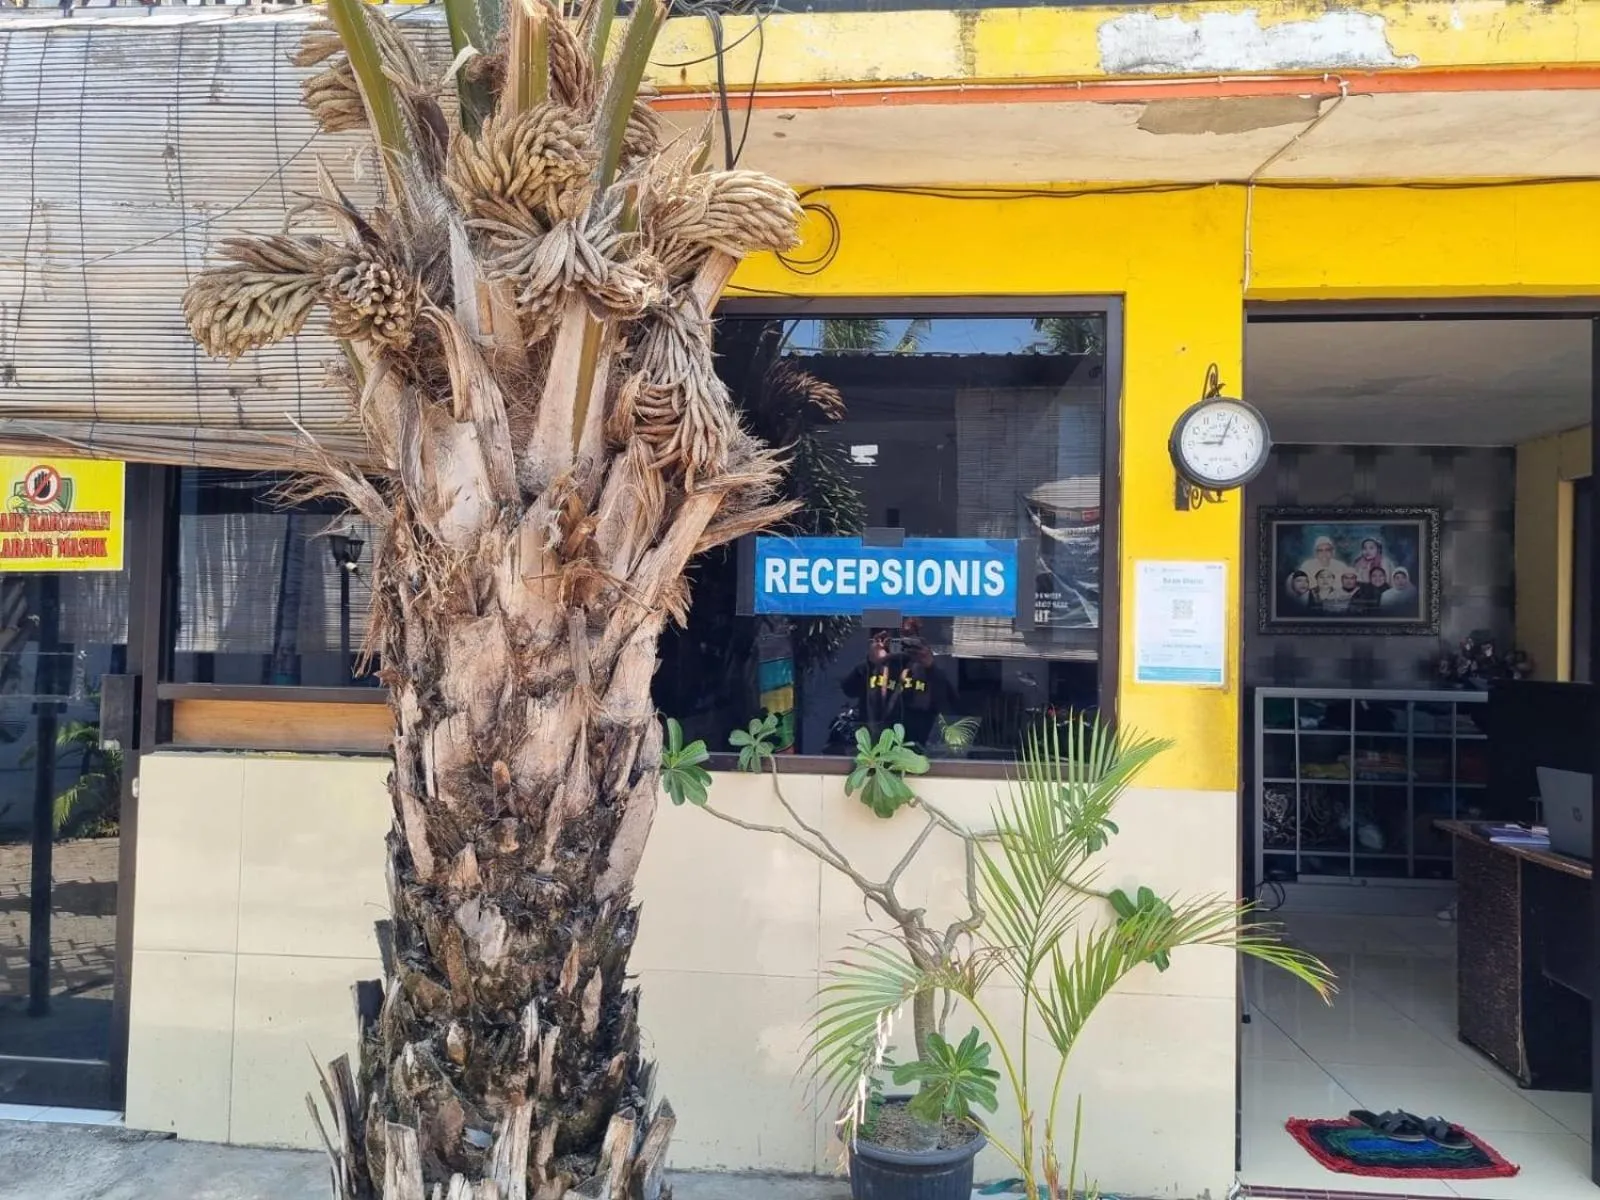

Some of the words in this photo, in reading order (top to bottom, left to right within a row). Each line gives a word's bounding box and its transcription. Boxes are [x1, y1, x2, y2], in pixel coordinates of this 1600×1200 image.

[0, 538, 52, 558] ARANG
[57, 537, 108, 558] MASUK
[764, 557, 1005, 597] RECEPSIONIS
